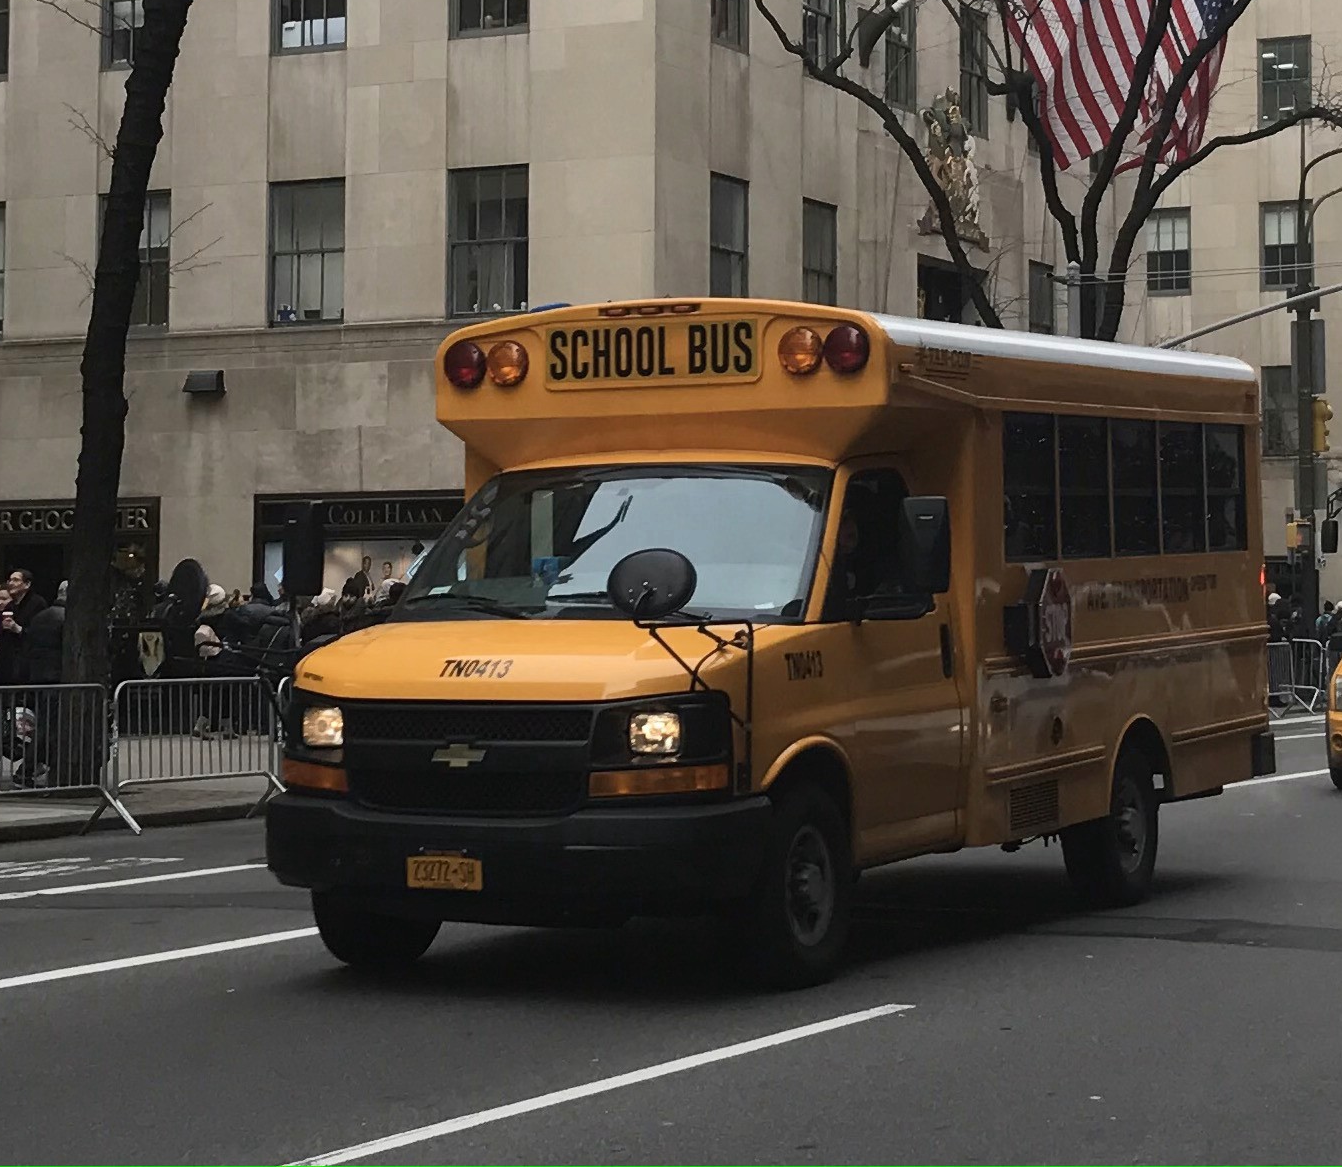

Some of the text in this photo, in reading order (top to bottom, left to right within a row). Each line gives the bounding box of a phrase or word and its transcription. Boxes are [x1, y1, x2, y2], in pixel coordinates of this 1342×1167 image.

[549, 321, 753, 381] SCHOOL BUS
[439, 659, 514, 678] TN0413
